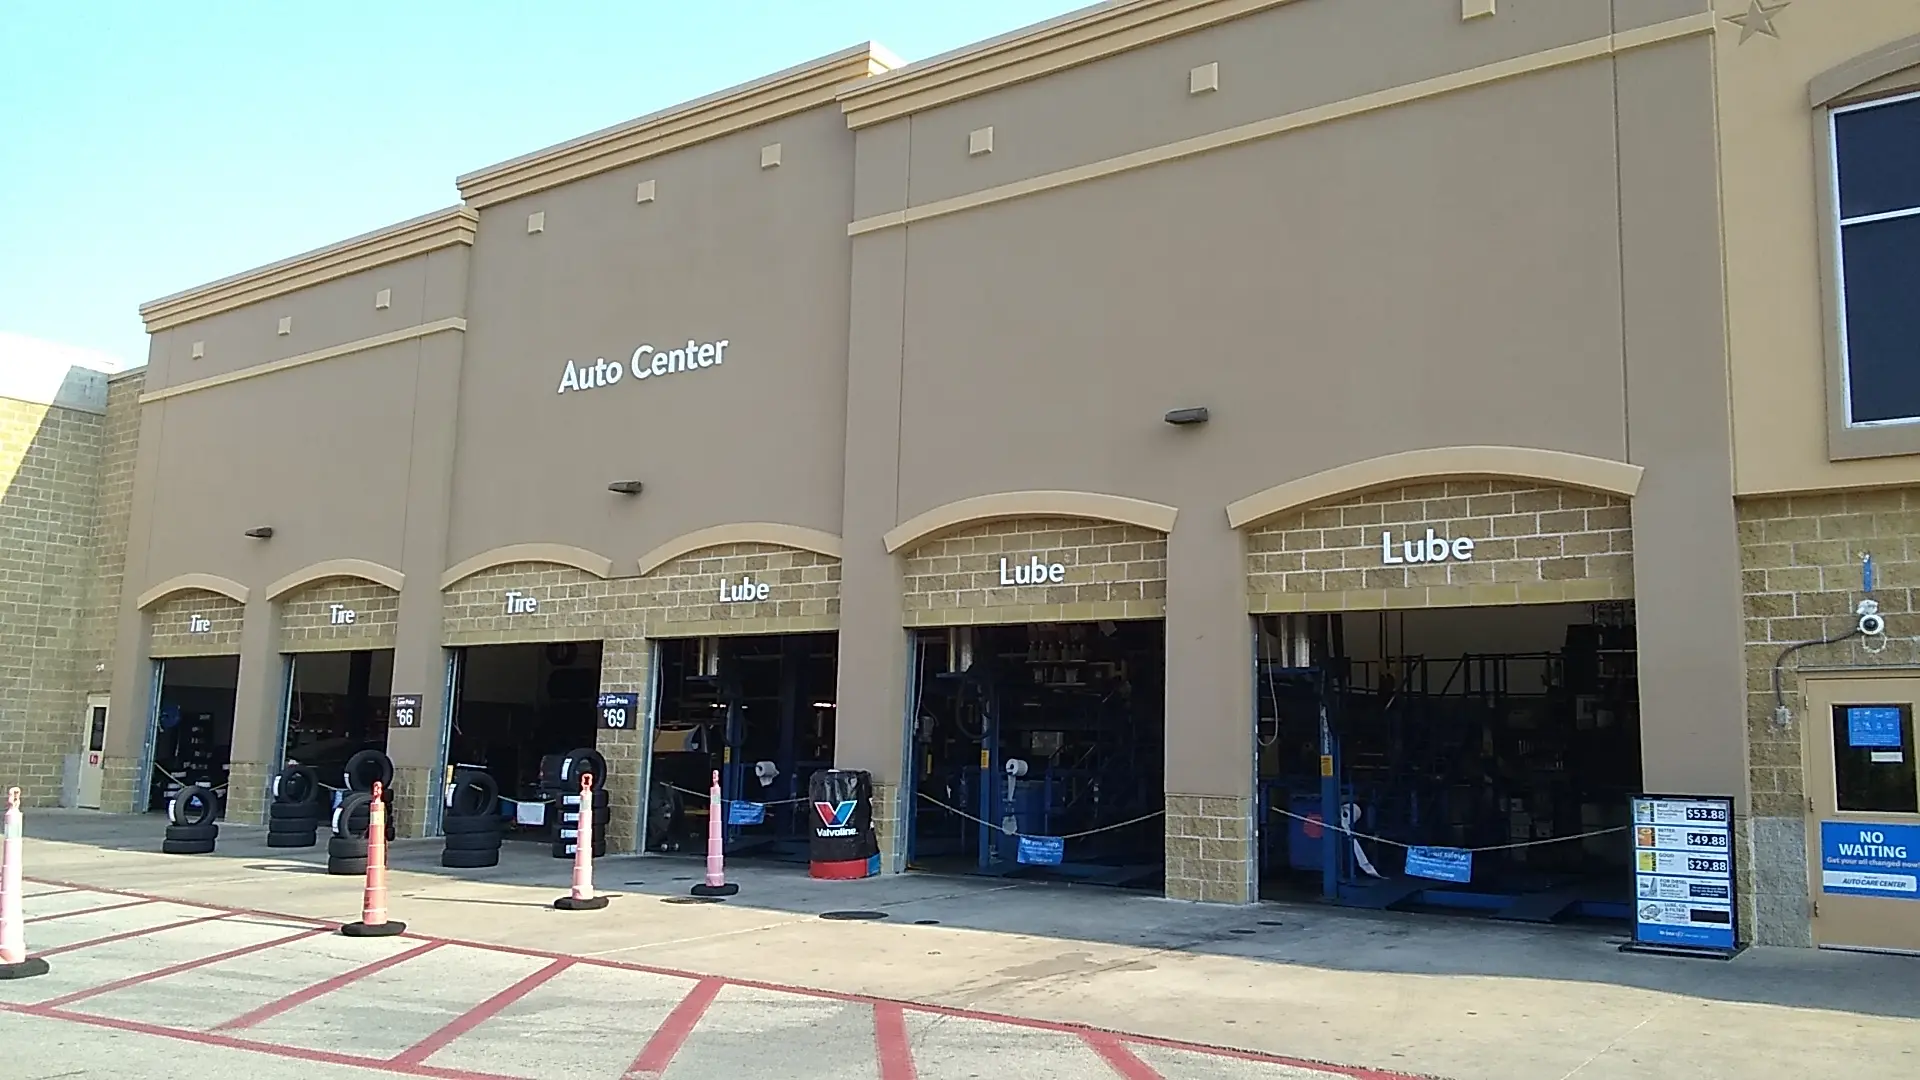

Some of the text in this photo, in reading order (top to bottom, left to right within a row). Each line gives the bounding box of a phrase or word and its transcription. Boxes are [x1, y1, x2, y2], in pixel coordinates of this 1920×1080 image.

[557, 340, 729, 393] Auto Center
[1383, 528, 1474, 564] Lube
[1000, 555, 1066, 585] Lube
[719, 577, 770, 603] Lube
[505, 591, 537, 614] Tire
[190, 614, 211, 633] Tire
[330, 604, 356, 625] Tire
[396, 708, 414, 726] $66
[603, 708, 626, 728] $69
[1687, 809, 1725, 819] $53.88
[816, 827, 857, 837] Valvoline
[1688, 834, 1726, 846] $49.88
[1859, 831, 1884, 844] NO
[1838, 844, 1907, 859] WAITING
[1688, 860, 1726, 871] $29.88
[1840, 858, 1857, 866] your
[1868, 860, 1901, 868] changed
